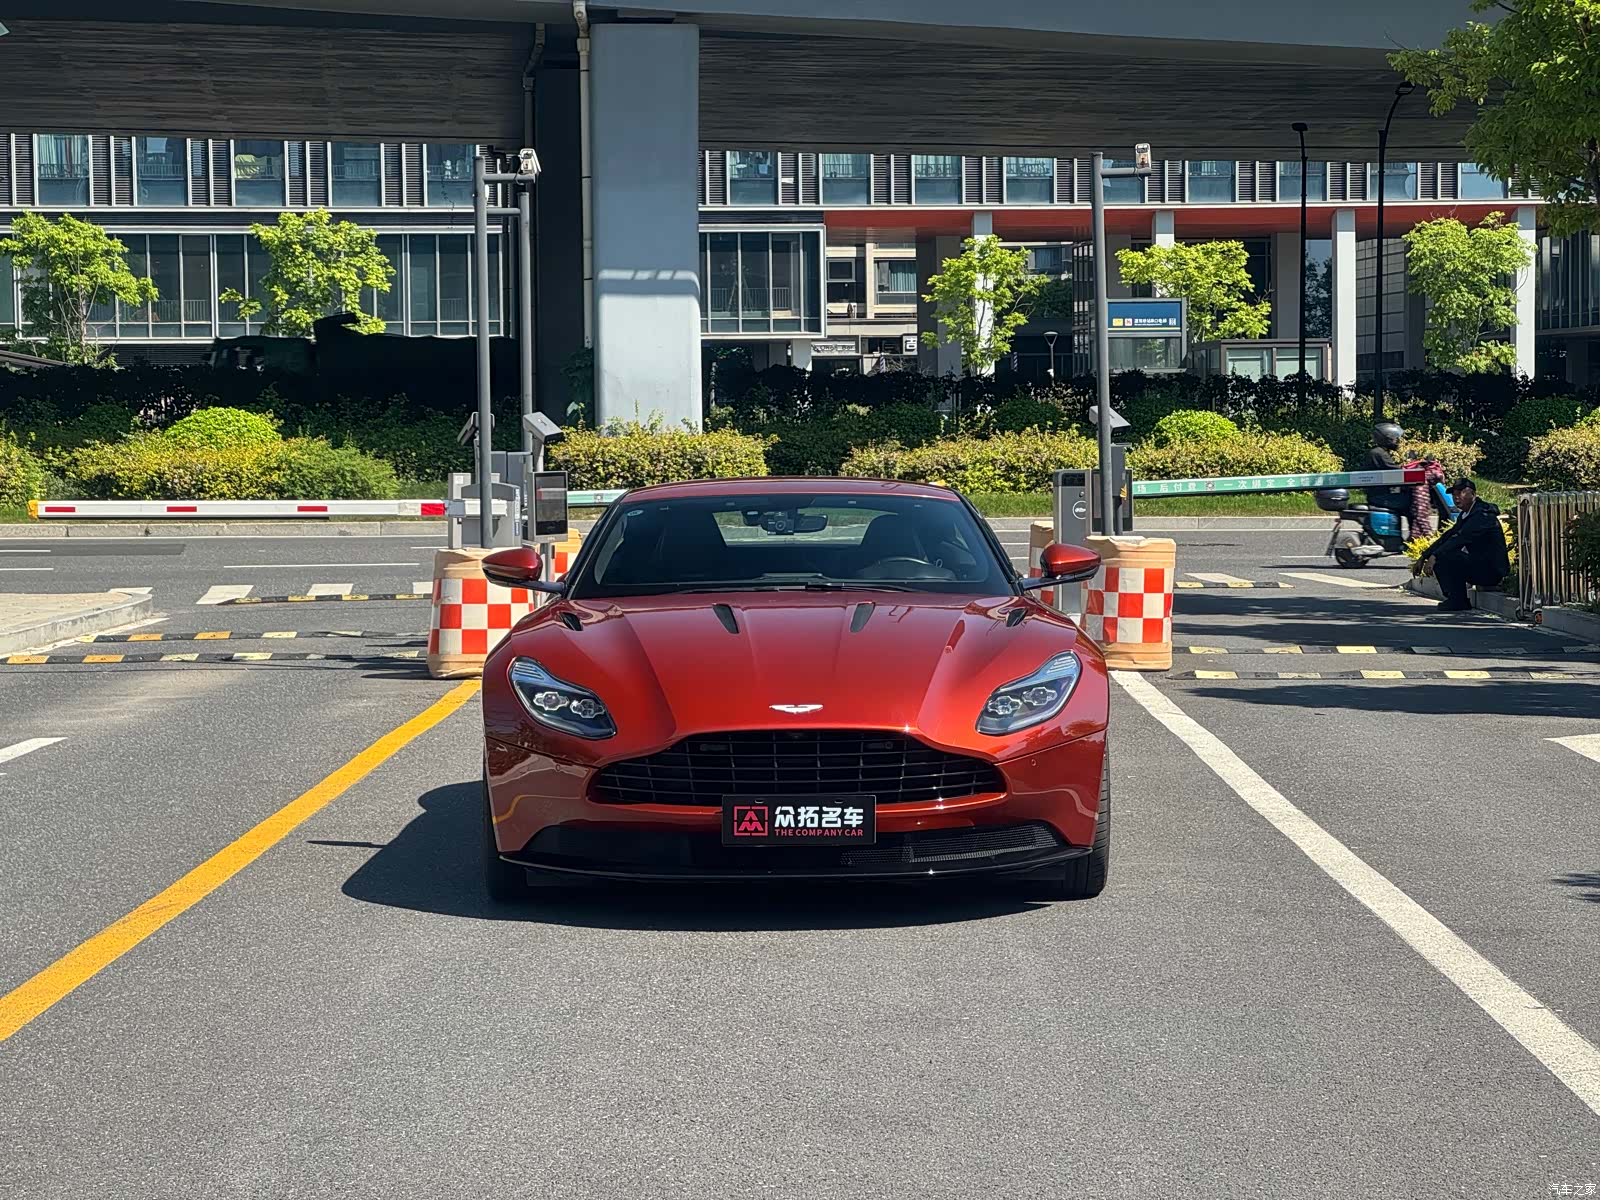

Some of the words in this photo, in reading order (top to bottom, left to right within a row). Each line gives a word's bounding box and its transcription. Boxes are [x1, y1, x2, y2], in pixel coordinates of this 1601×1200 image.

[1223, 477, 1276, 490] 一次绑定
[775, 806, 864, 828] 众拓名车
